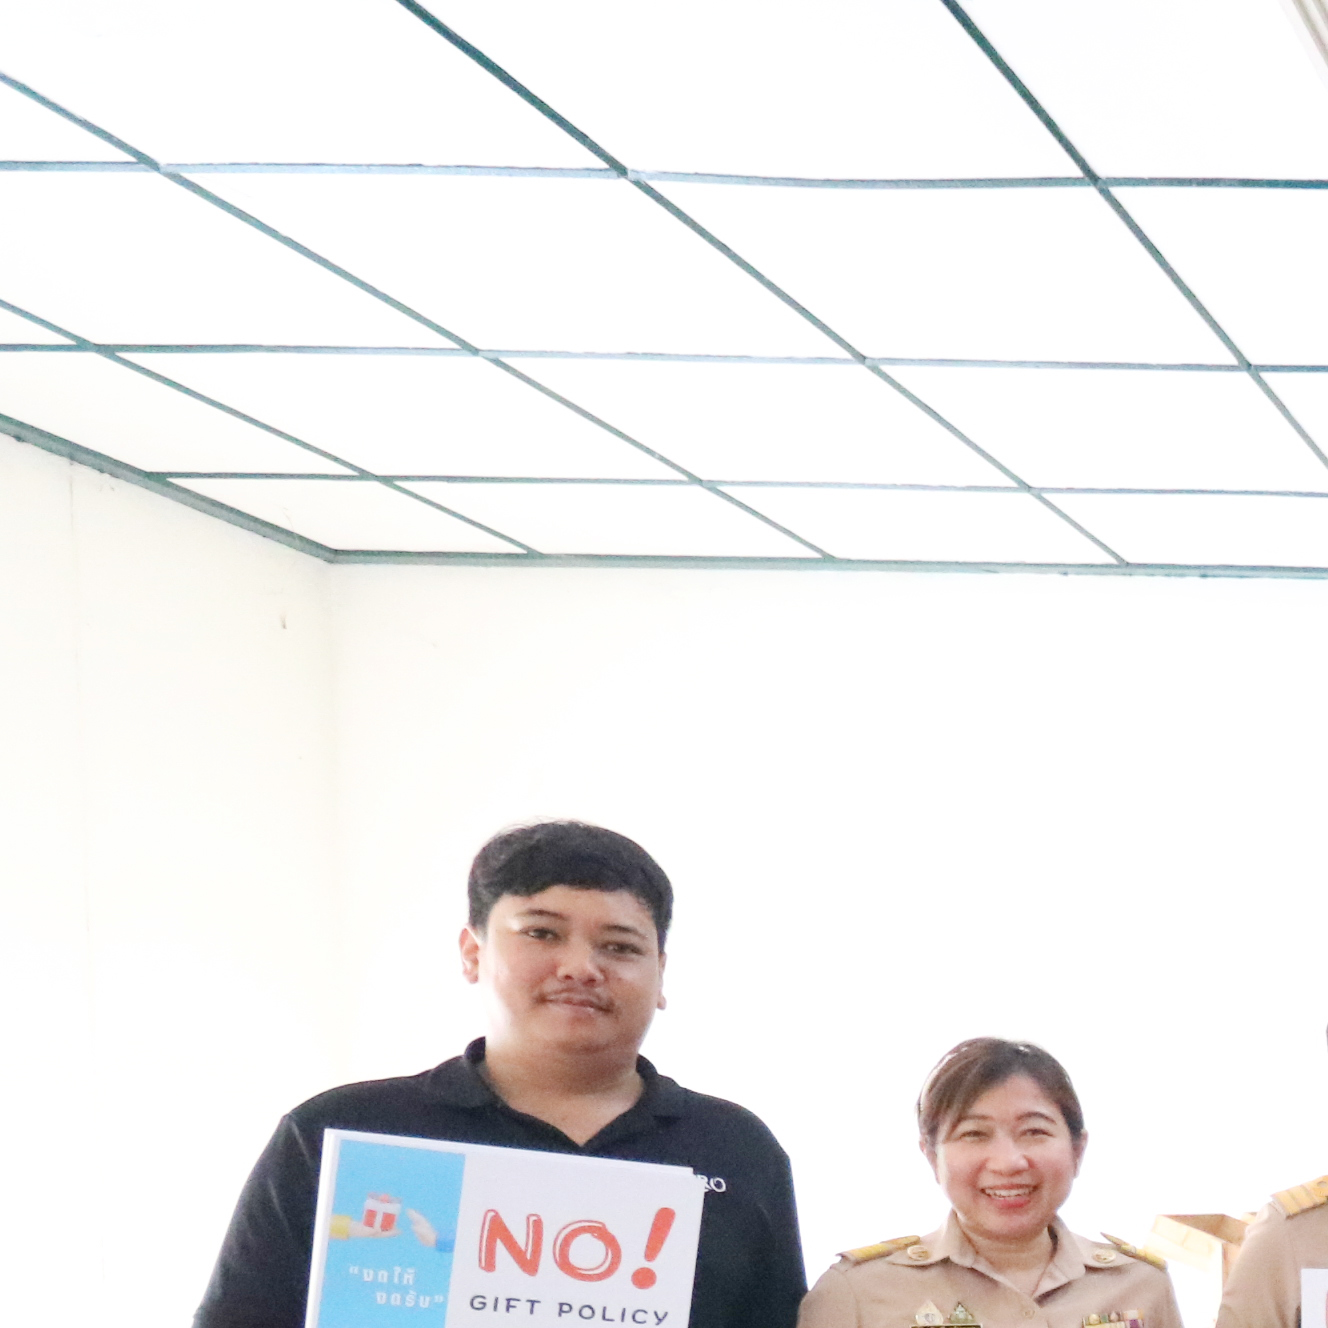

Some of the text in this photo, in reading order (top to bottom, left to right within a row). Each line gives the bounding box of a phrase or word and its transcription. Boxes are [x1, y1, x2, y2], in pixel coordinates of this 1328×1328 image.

[478, 1206, 676, 1290] NO!
[469, 1293, 670, 1327] GIFT POLICY
